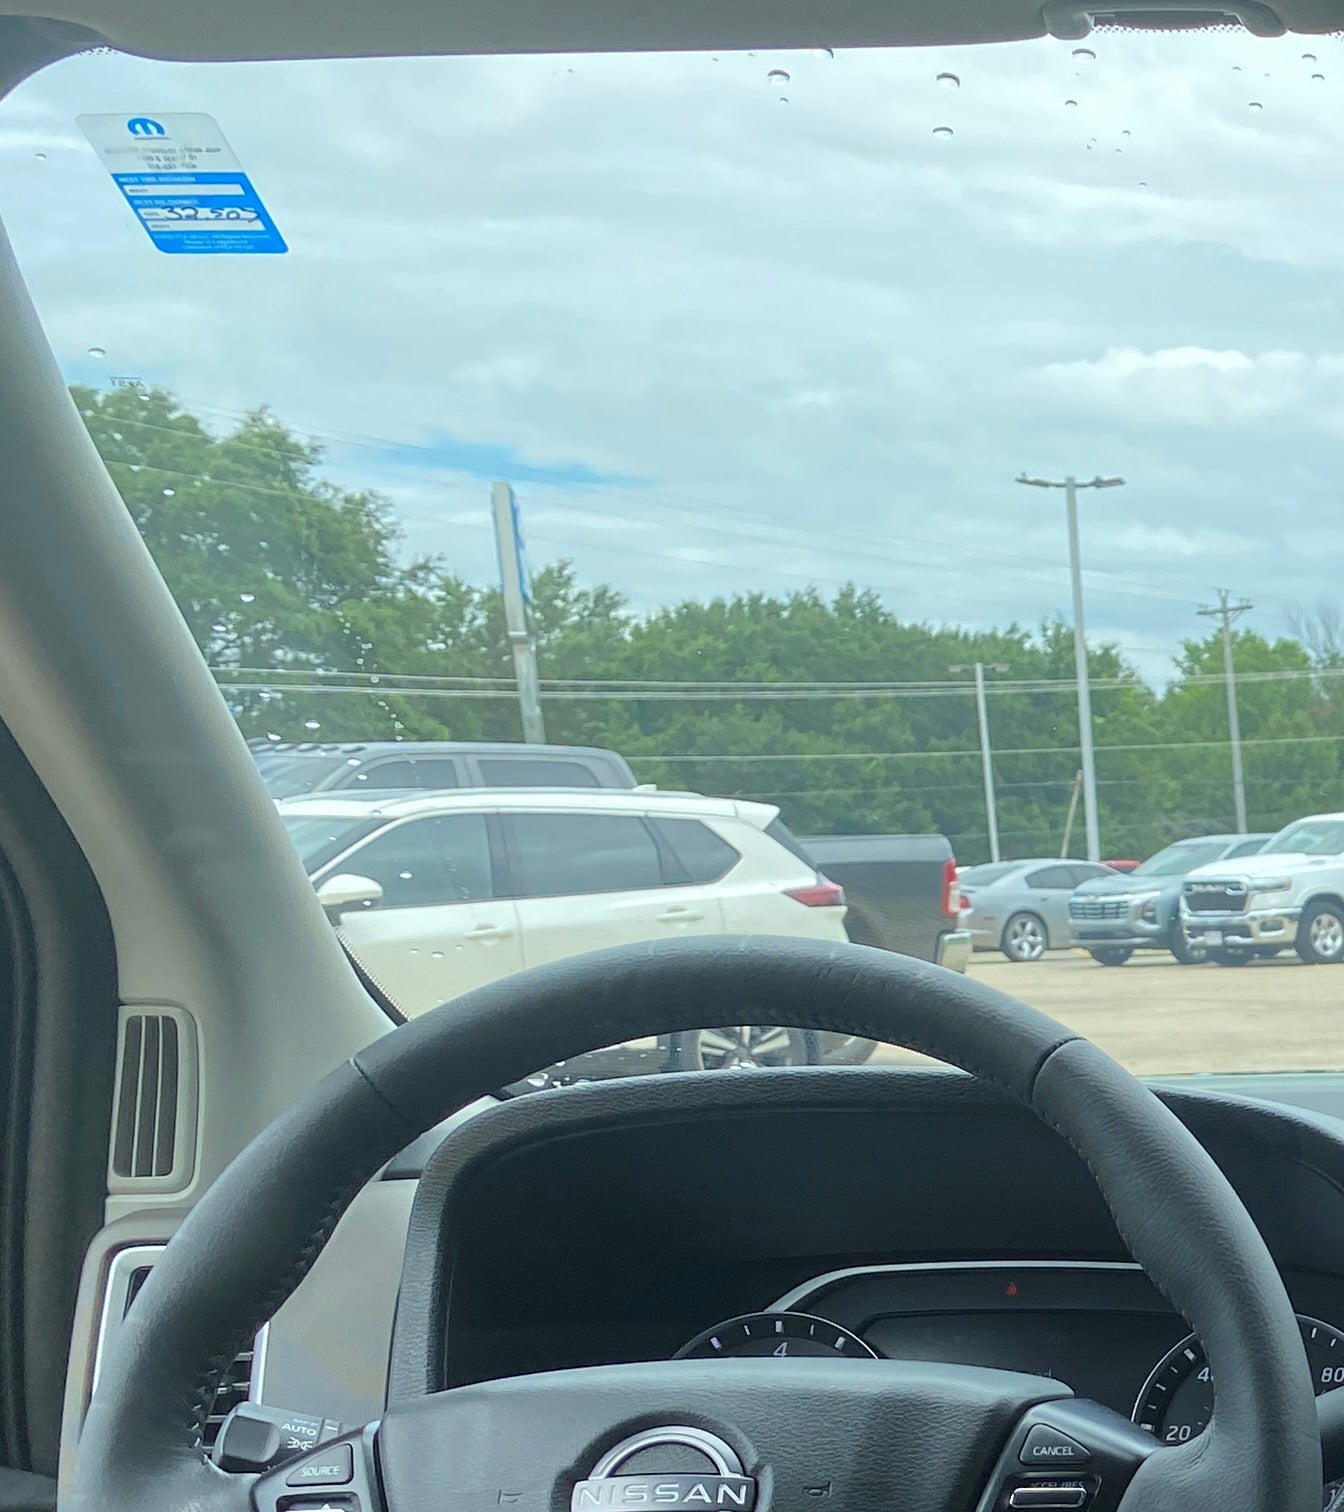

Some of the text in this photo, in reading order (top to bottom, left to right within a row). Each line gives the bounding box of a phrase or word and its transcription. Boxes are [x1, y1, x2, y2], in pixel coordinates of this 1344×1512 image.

[773, 1342, 787, 1357] 4
[282, 1423, 317, 1436] AUTO
[1166, 1425, 1192, 1441] 20
[1033, 1446, 1074, 1456] CANCEL
[301, 1465, 340, 1477] SOURCE
[578, 1483, 747, 1507] NISSAN
